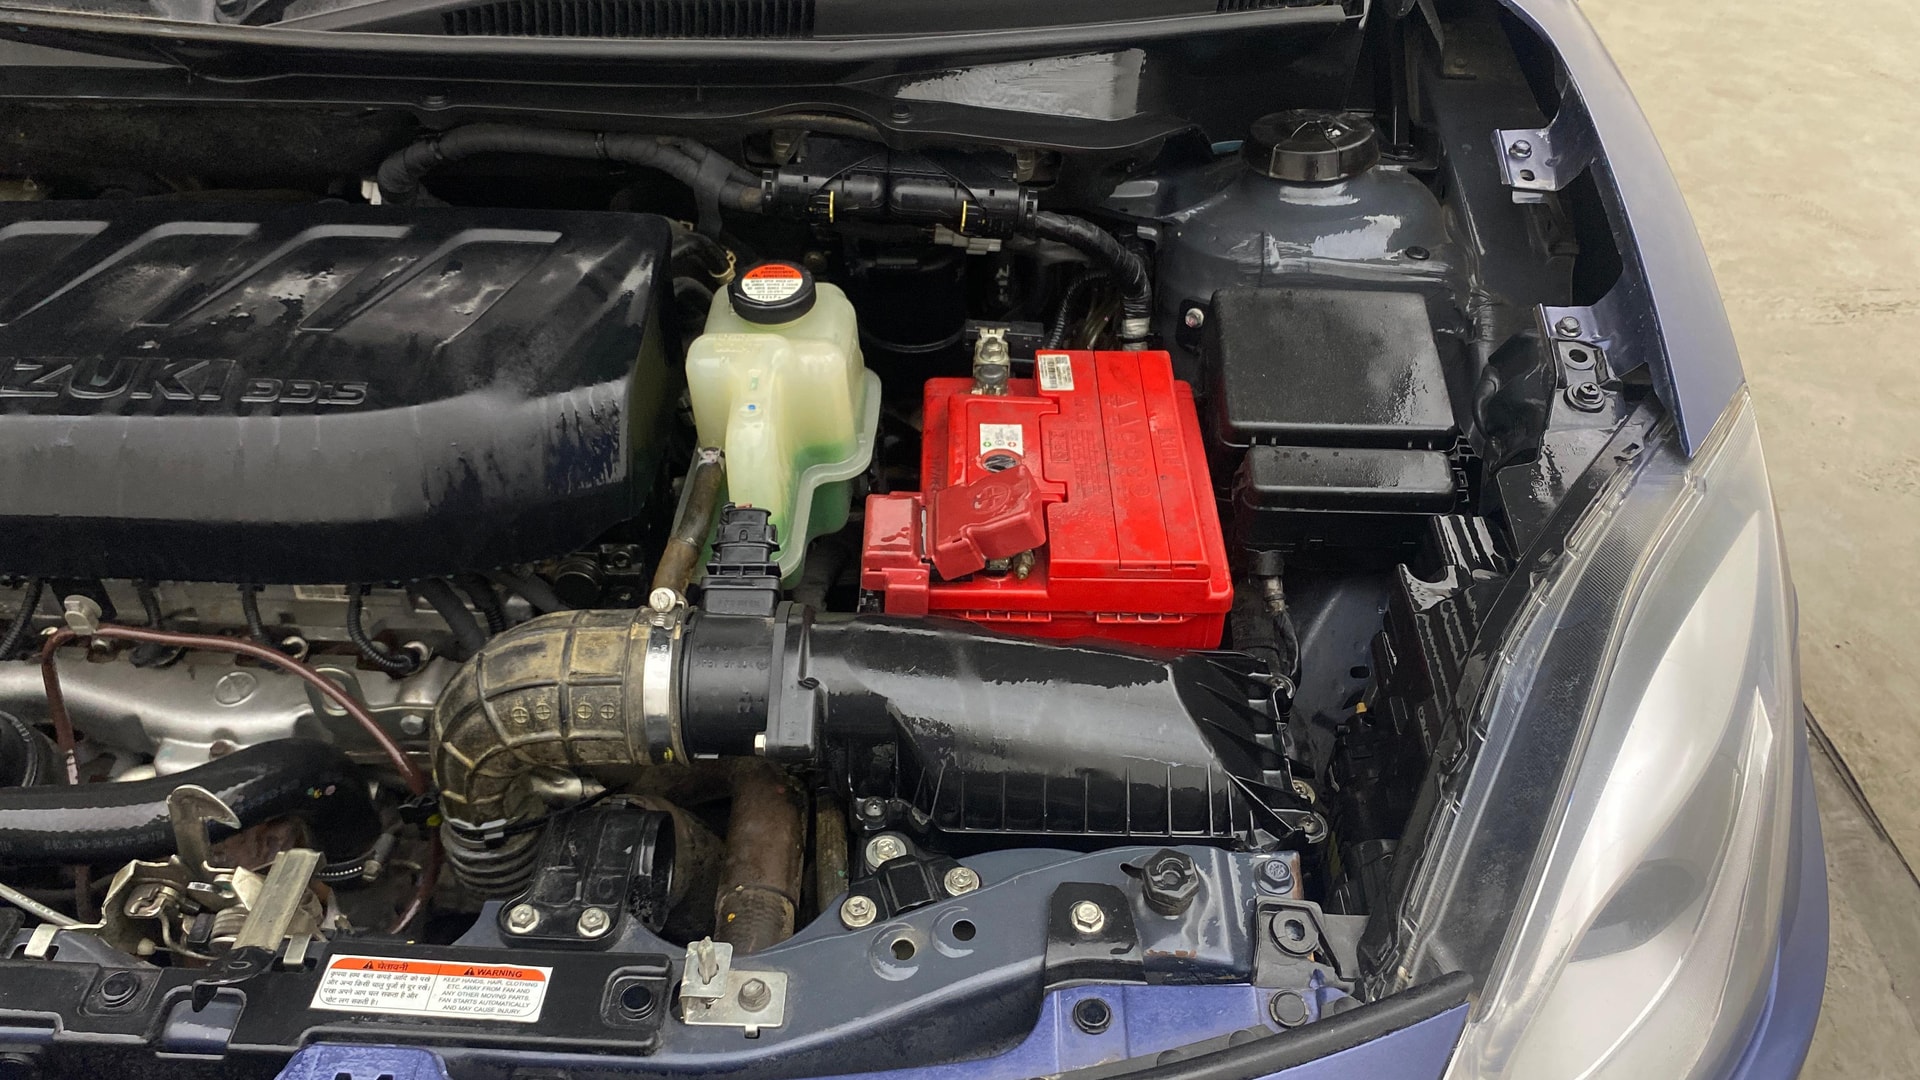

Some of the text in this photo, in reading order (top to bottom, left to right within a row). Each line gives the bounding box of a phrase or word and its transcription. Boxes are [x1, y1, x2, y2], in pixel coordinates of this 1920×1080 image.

[0, 355, 236, 402] ZUKI
[477, 968, 523, 978] WARNING
[479, 1000, 531, 1008] AUTOMATICALLY
